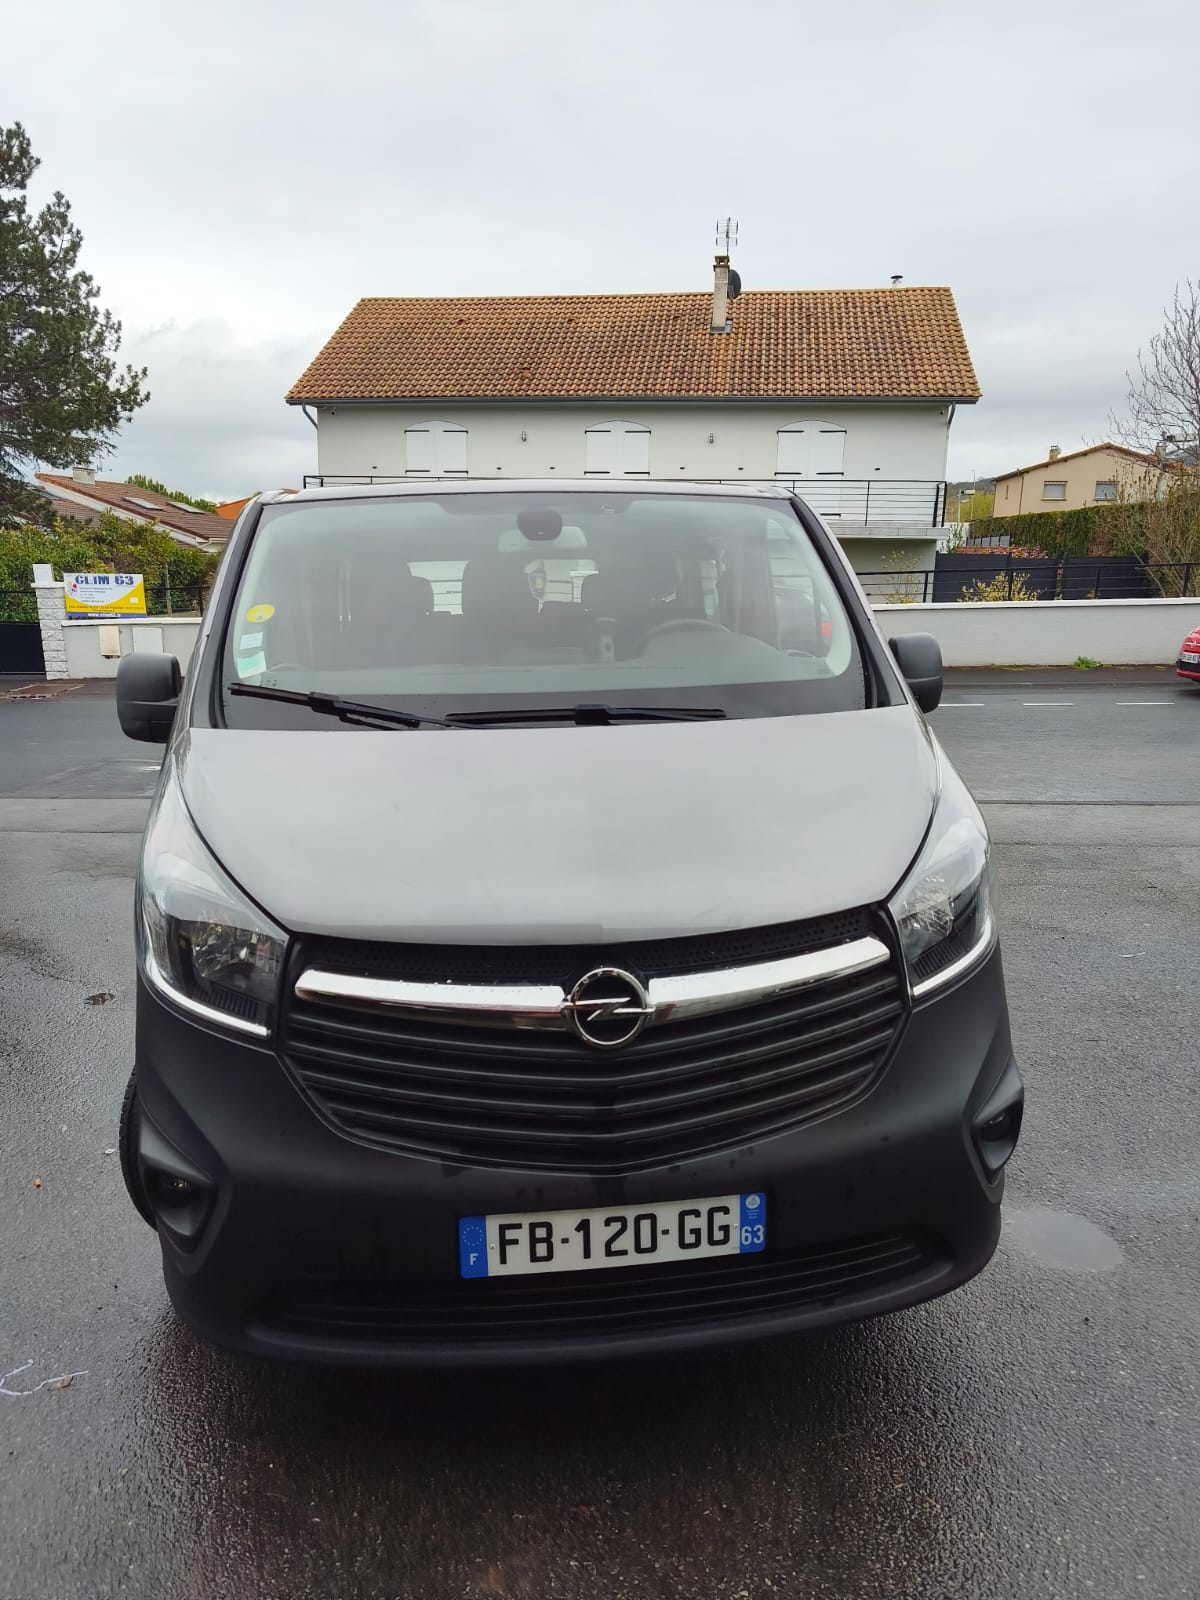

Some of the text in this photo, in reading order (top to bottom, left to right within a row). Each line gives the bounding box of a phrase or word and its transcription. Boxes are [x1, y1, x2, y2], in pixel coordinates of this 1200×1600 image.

[75, 575, 134, 585] CLIM 63
[498, 1206, 730, 1265] FB-120-GG
[741, 1225, 764, 1245] 63
[470, 1253, 478, 1265] F
